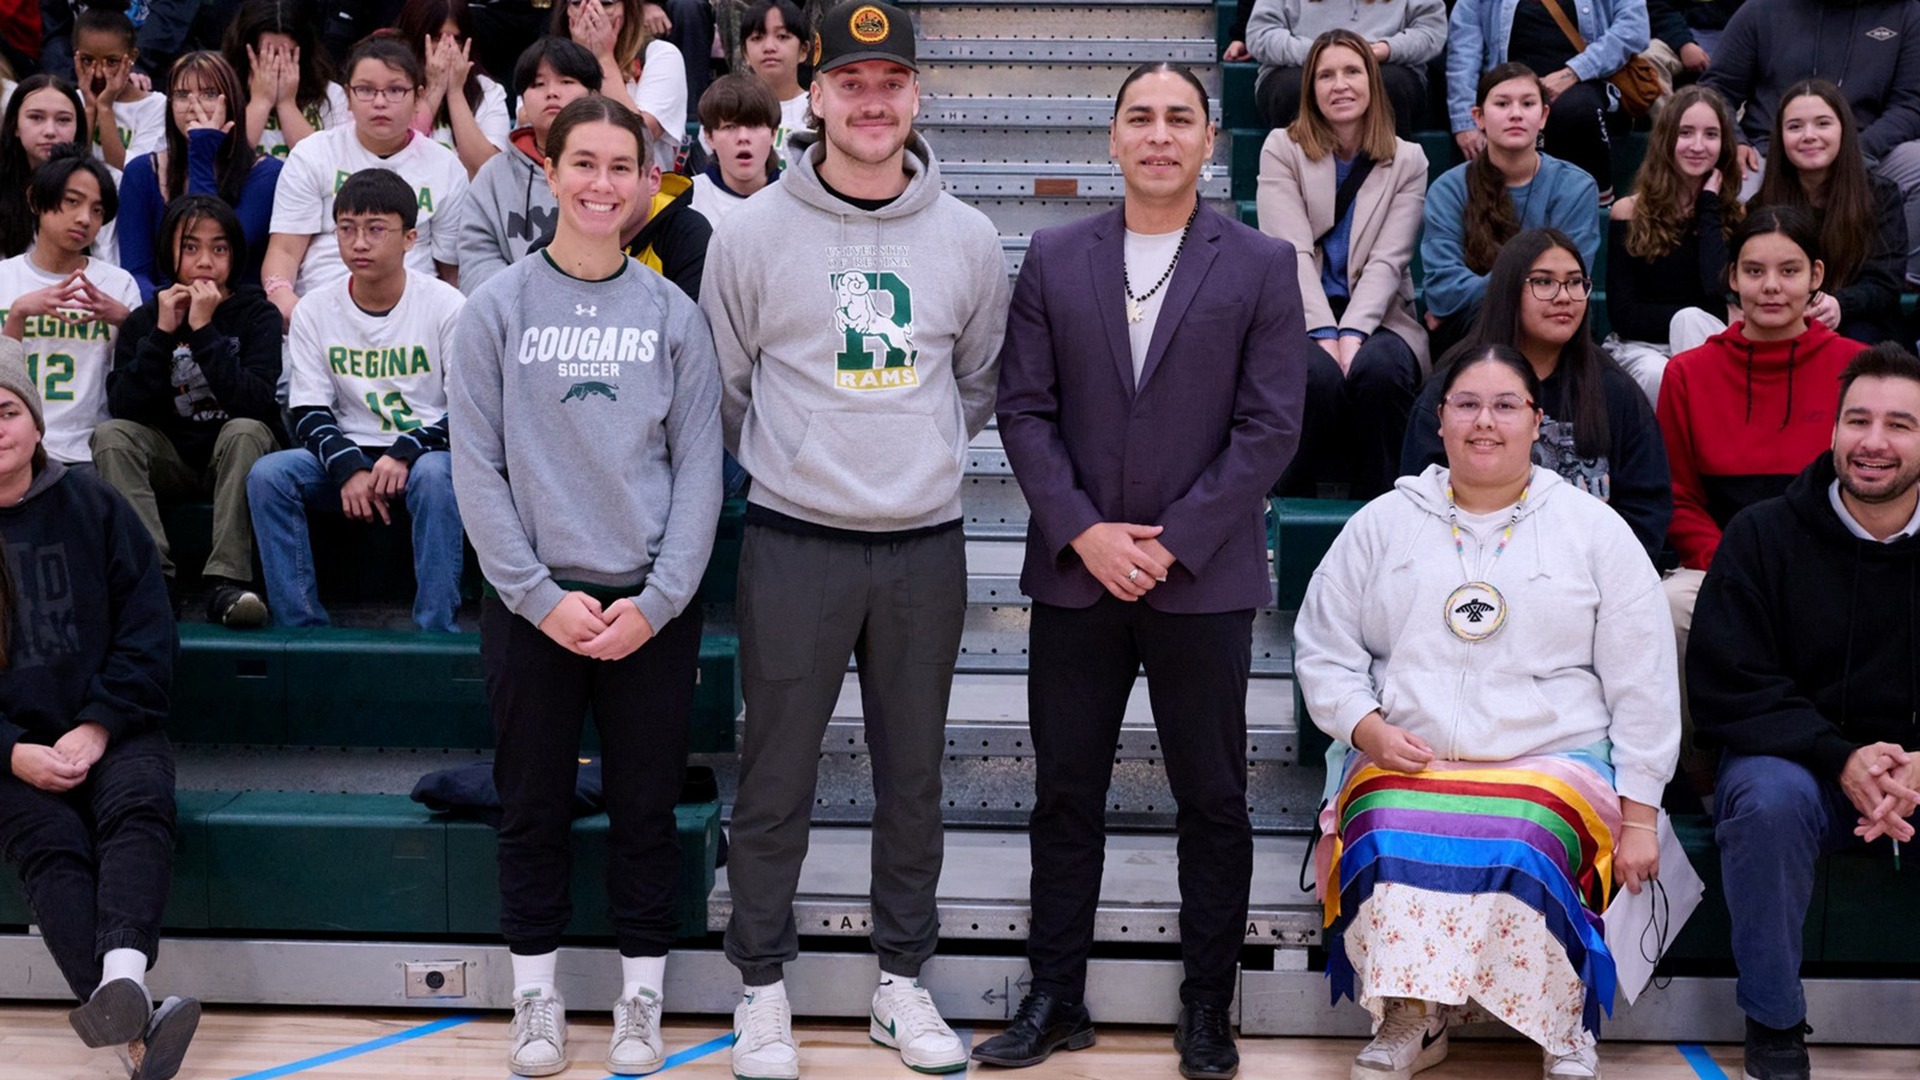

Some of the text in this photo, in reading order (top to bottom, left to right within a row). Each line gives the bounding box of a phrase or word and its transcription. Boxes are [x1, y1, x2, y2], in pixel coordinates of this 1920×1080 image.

[949, 111, 957, 120] H
[825, 245, 910, 257] UNIVERSITY
[828, 257, 911, 269] OF REGINA
[517, 326, 660, 365] COUGARS
[328, 344, 431, 379] REGINA
[26, 352, 75, 402] 12
[558, 363, 621, 377] SOCCER
[840, 370, 915, 388] RAMS
[365, 391, 423, 432] 12
[840, 916, 853, 929] A
[1246, 922, 1259, 936] A
